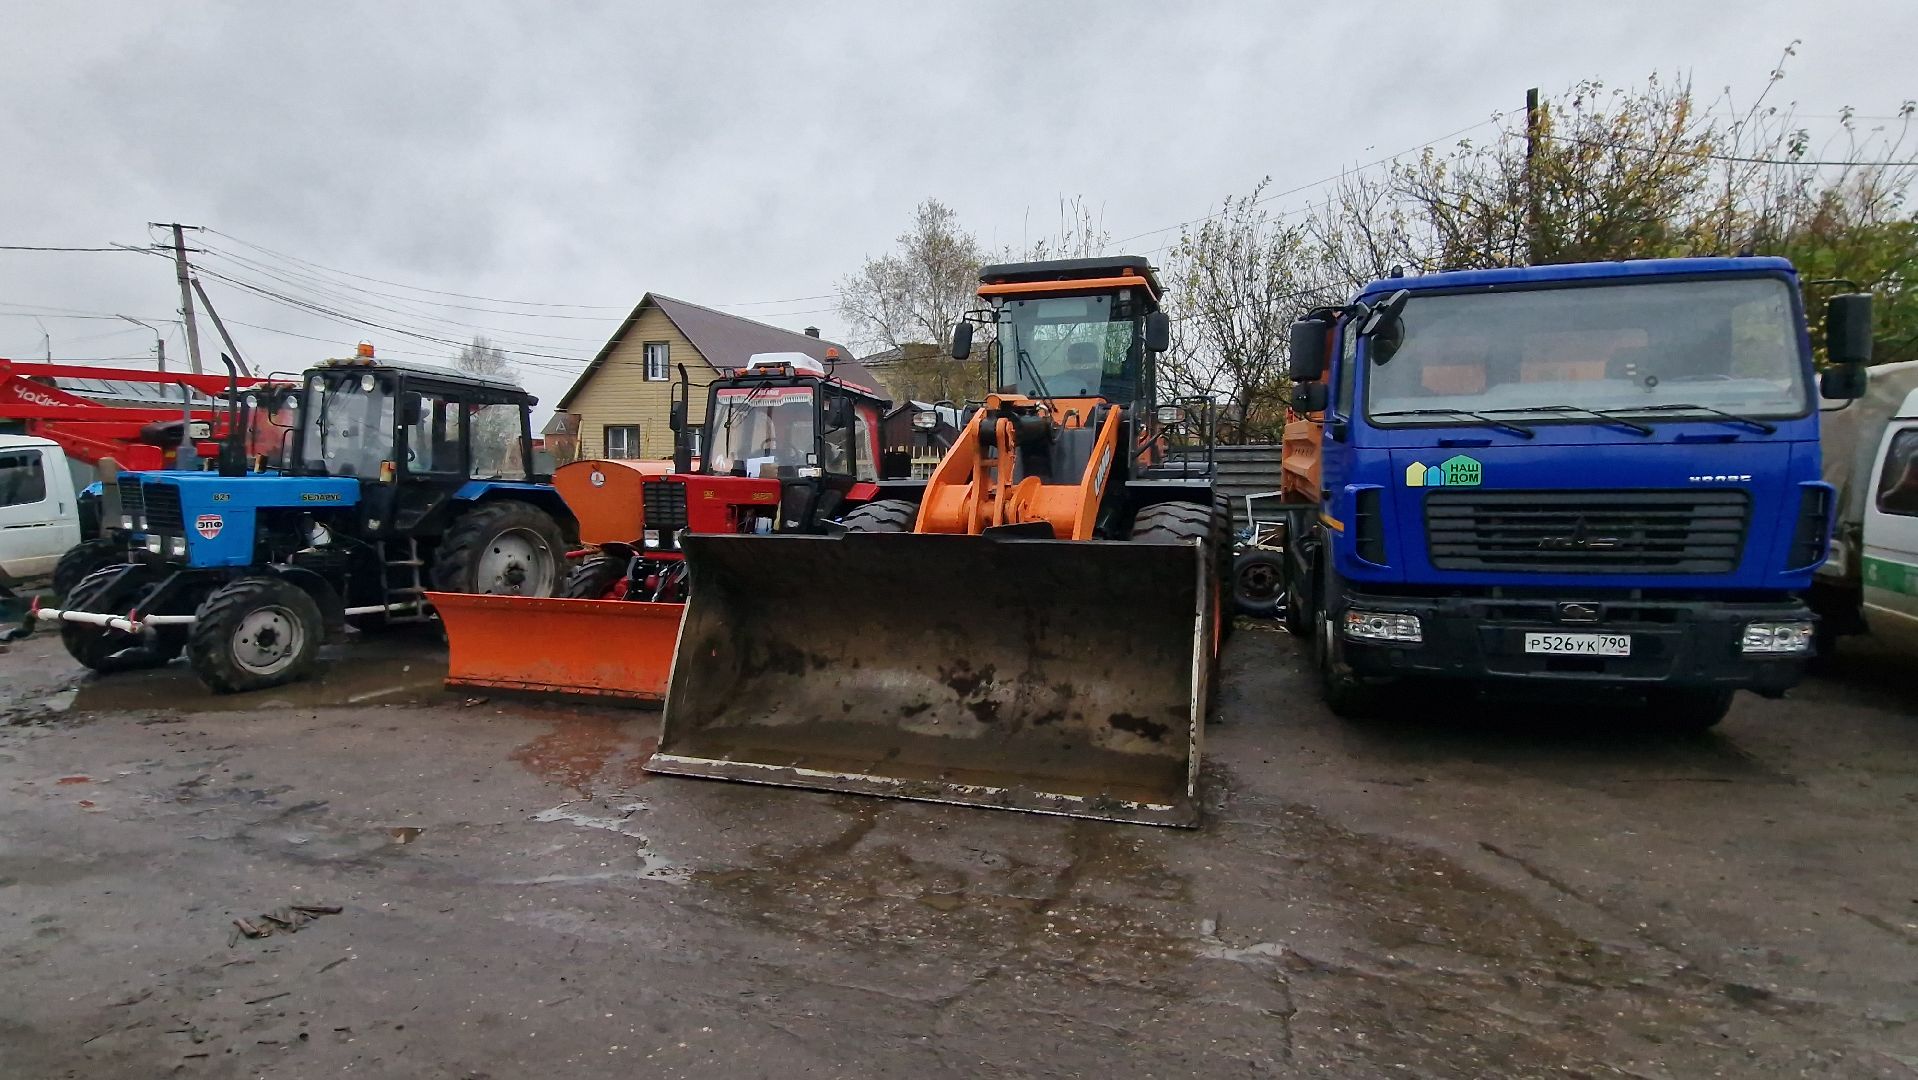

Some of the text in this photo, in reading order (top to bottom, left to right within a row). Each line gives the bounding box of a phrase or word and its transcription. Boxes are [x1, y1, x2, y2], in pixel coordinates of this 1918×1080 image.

[1450, 463, 1479, 473] НАШ
[1449, 473, 1479, 484] ДОМ
[197, 521, 223, 529] ЭПФ
